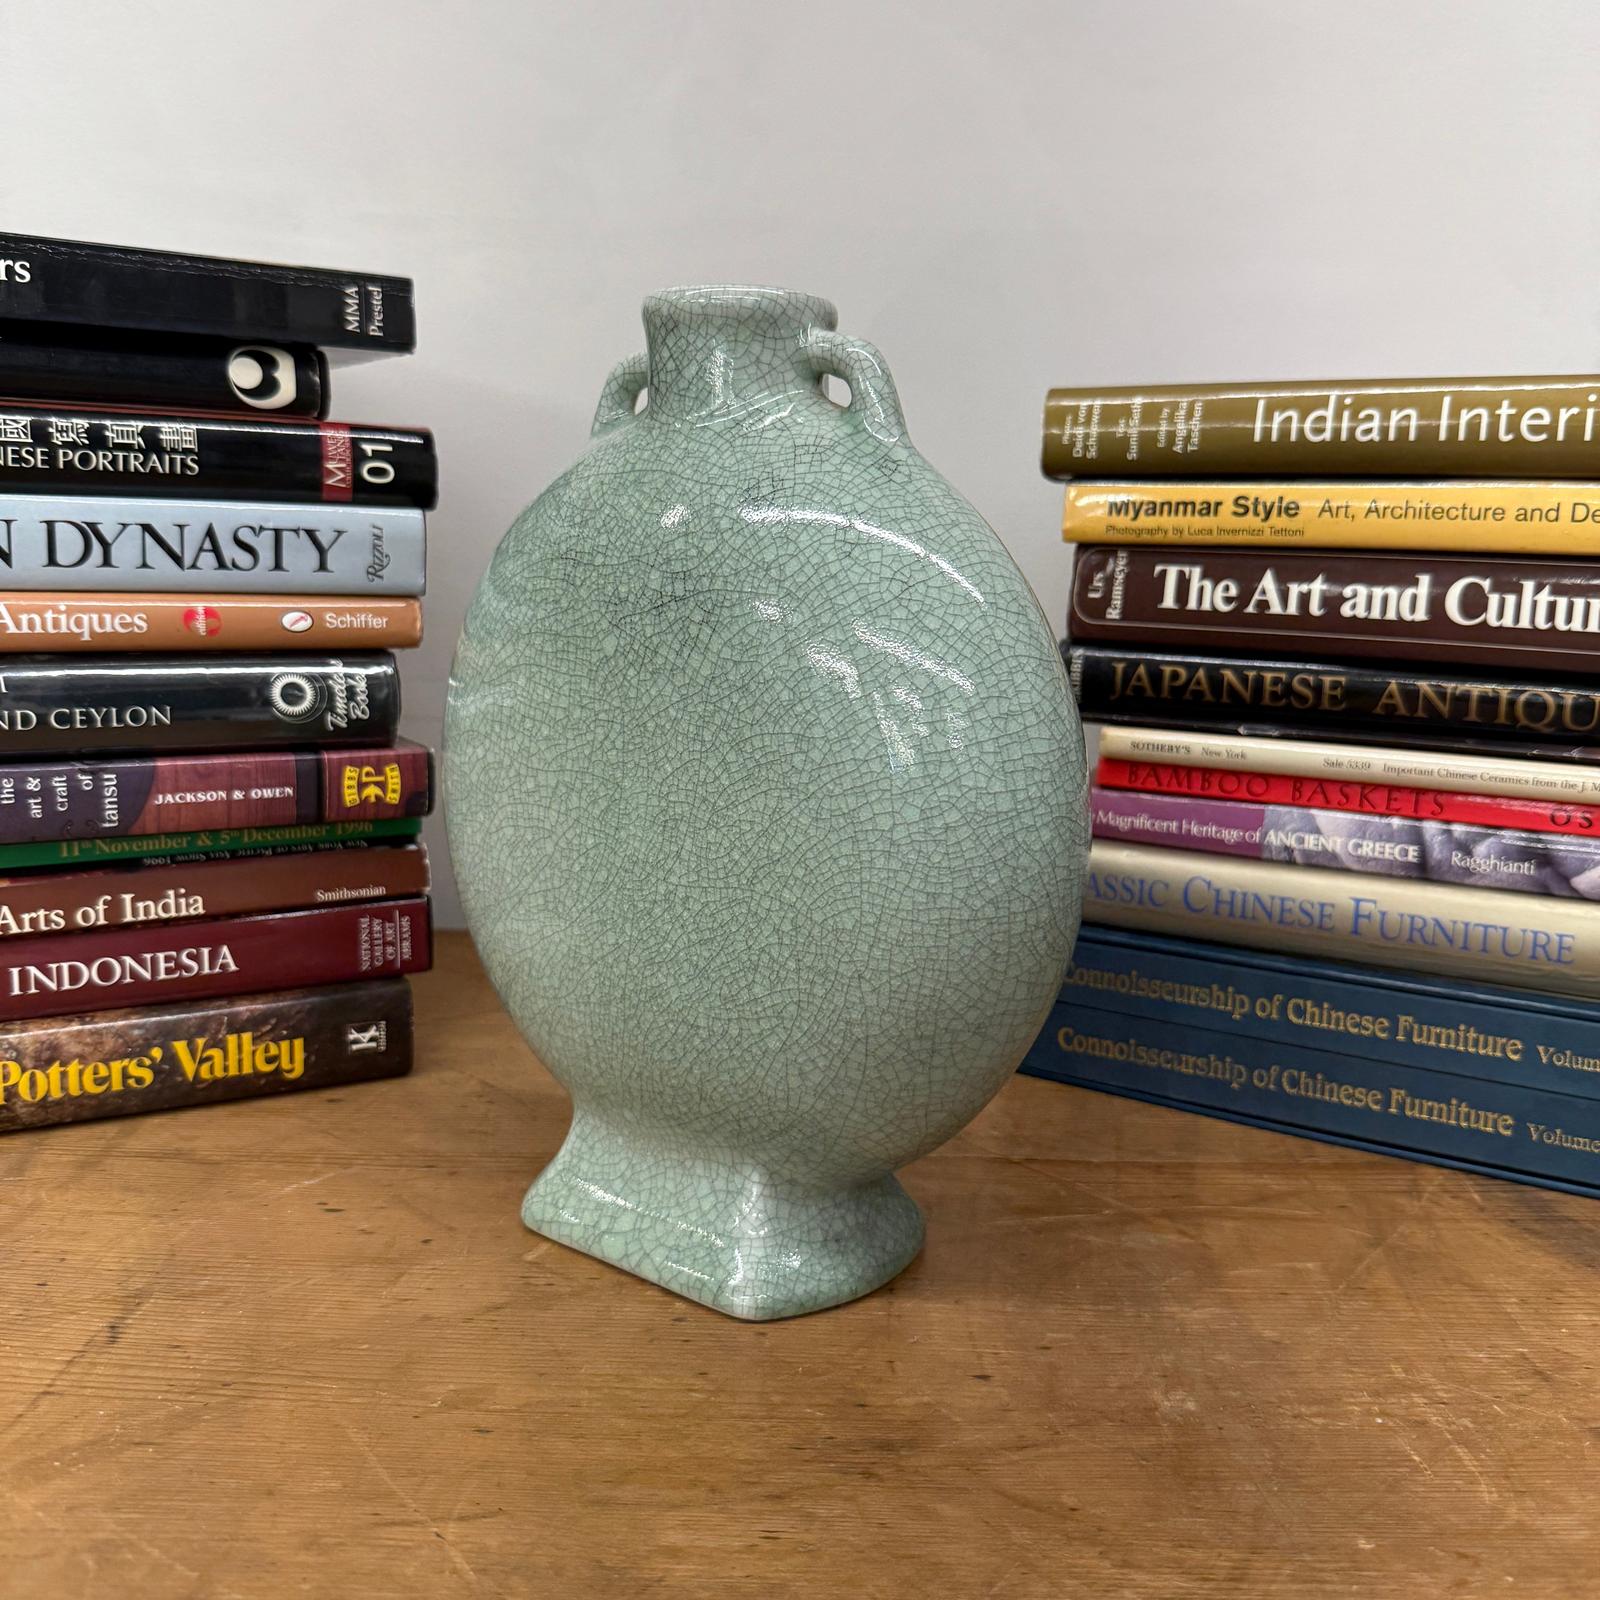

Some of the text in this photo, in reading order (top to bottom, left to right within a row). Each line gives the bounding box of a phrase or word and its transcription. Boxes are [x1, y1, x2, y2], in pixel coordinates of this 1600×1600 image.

[343, 287, 360, 333] MMA
[368, 287, 384, 337] Prestel
[1156, 407, 1171, 448] Edited by
[1172, 399, 1189, 454] Angelika
[1187, 400, 1204, 453] Taschen
[1253, 391, 1599, 443] Indian Interi
[0, 446, 200, 476] ESE PORTRAITS
[359, 442, 395, 484] 01
[1105, 525, 1305, 537] Photography by Luca Invernizzi Tettoni
[1106, 495, 1600, 523] Myanmar Style Art, Architecture and De
[40, 519, 348, 575] DYNASTY
[366, 524, 391, 584] RIZZOLI
[1088, 572, 1106, 599] Urs
[1106, 550, 1130, 621] Ramseyer
[1154, 562, 1240, 613] The
[1243, 567, 1328, 617] Art
[1340, 573, 1431, 622] and
[0, 602, 149, 641] Antiques
[326, 613, 389, 631] Schiffer
[50, 705, 172, 730] CEYLON
[1111, 661, 1347, 711] JAPANESE
[1372, 680, 1600, 731] ANTIQU
[77, 773, 93, 791] of
[1130, 740, 1191, 754] SOTHEBY'S
[1201, 747, 1221, 758] New
[1224, 749, 1247, 760] York
[1322, 758, 1344, 769] Sale
[1383, 763, 1435, 778] Important
[1437, 768, 1478, 782] Chinese
[1480, 772, 1530, 786] Ceramics
[1531, 776, 1558, 788] from
[1560, 780, 1578, 790] the
[0, 777, 15, 804] the
[26, 777, 42, 818] art &
[51, 775, 68, 811] craft
[101, 774, 119, 828] tansu
[154, 786, 294, 805] JACKSON & OWEN
[1127, 764, 1270, 798] BAMBOO
[1290, 779, 1446, 816] BASKETS
[95, 832, 188, 856] November
[195, 832, 213, 846] &
[243, 824, 330, 843] December
[1097, 810, 1536, 875] Magnificent Heritage of ANCIENT GREECE Ragghianti
[0, 887, 207, 936] Arts of India
[316, 885, 387, 902] Smithsonian
[1183, 876, 1336, 932] CHINESE
[1349, 896, 1576, 965] FURNITURE
[8, 944, 240, 997] INDONESIA
[171, 1031, 305, 1082] Valley
[1255, 993, 1284, 1020] of
[1287, 997, 1391, 1040] Chinese
[1396, 1014, 1525, 1061] Furniture
[1536, 1044, 1600, 1073] Volum
[1057, 1027, 1600, 1154] Connoisseurship of Chinese Furniture Volume
